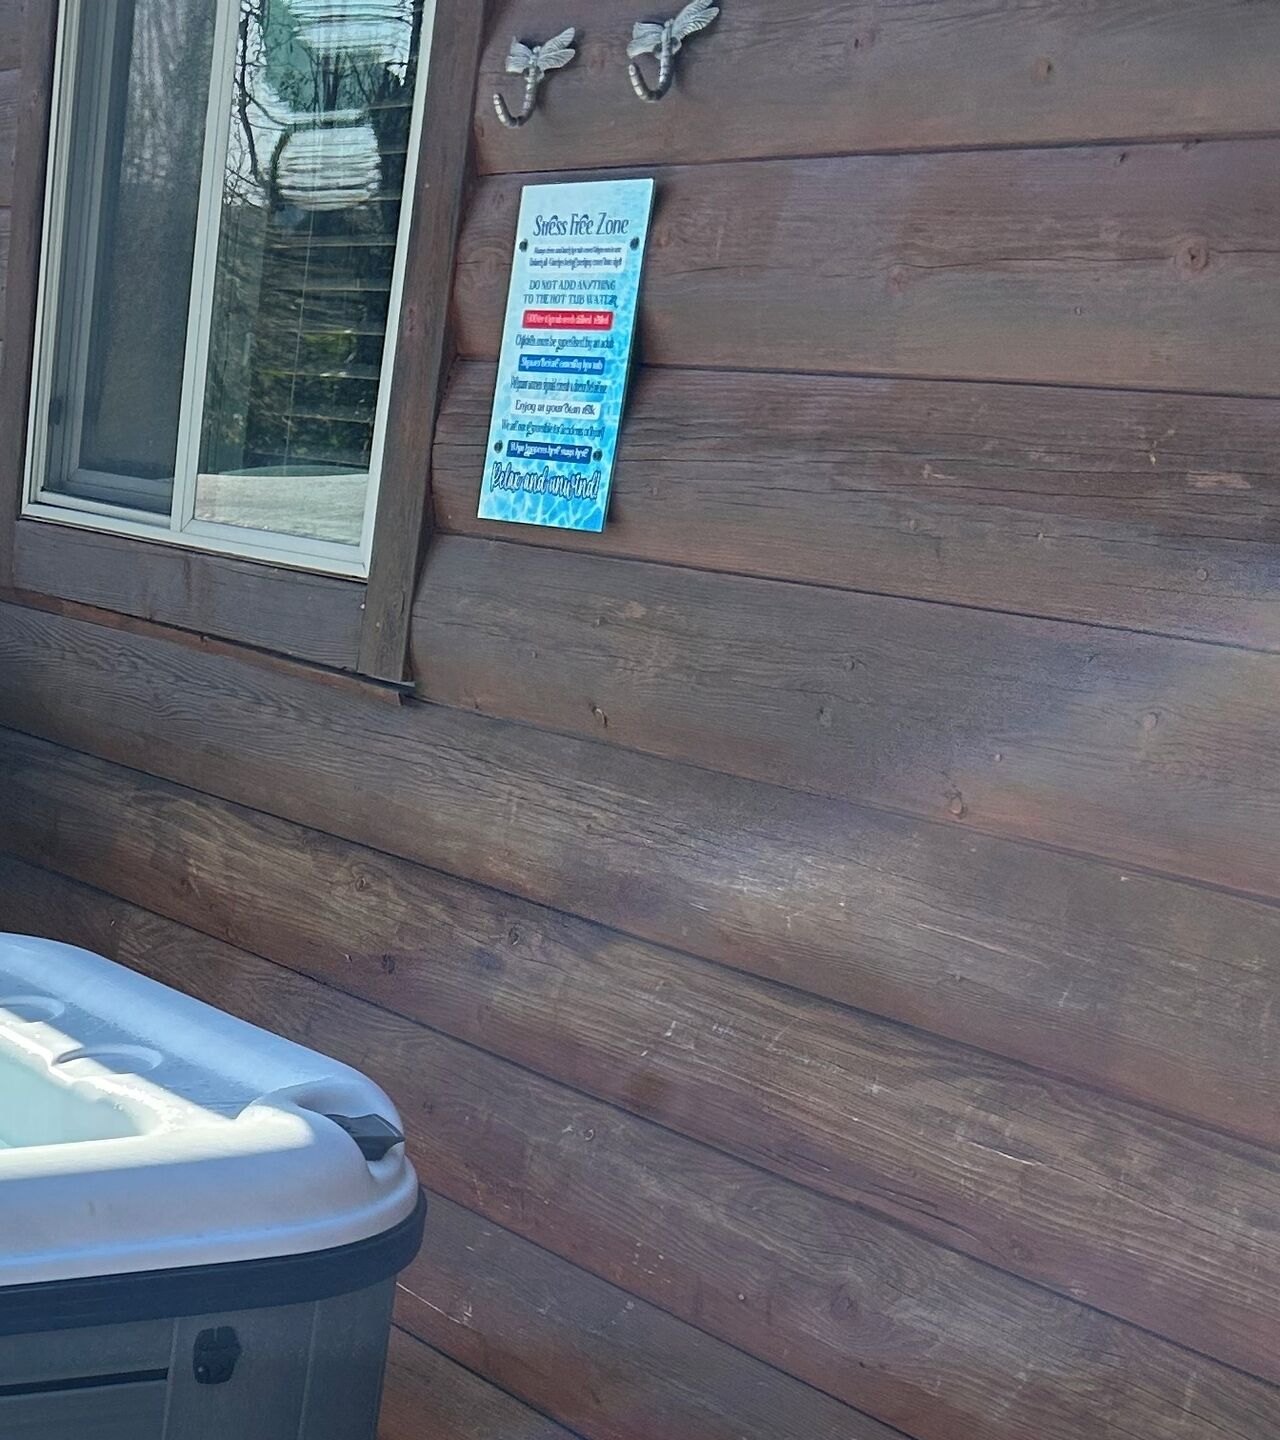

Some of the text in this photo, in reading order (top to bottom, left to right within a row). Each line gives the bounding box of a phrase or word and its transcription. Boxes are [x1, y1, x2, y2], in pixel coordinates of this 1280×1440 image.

[533, 212, 629, 236] Stress Free Zone
[515, 400, 536, 413] Enjoy
[490, 461, 522, 492] Relax
[522, 465, 549, 494] and
